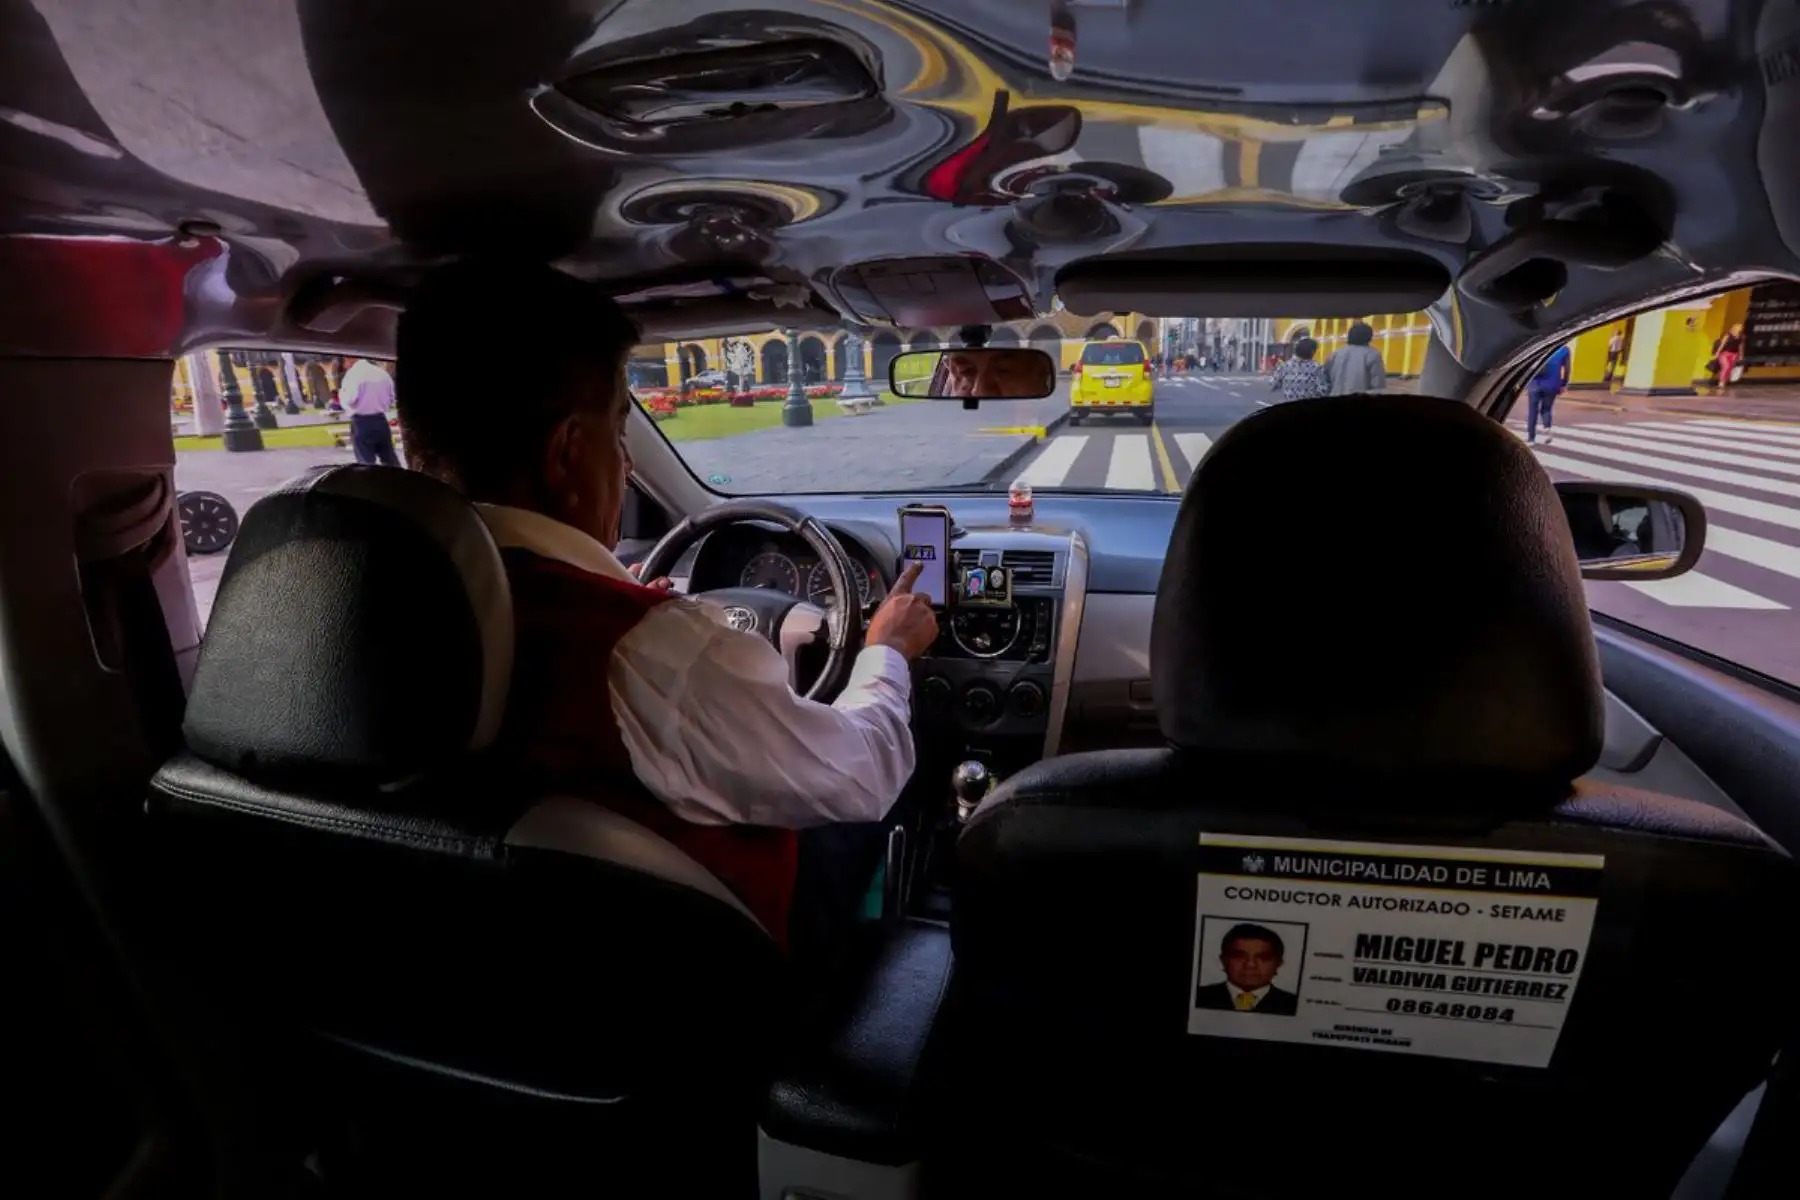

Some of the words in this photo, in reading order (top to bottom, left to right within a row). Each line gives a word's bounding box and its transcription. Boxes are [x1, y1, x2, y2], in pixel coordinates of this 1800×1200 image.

[1273, 855, 1449, 885] MUNICIPALIDAD
[1456, 867, 1487, 887] DE
[1494, 870, 1551, 890] LIMA
[1224, 886, 1340, 907] CONDUCTOR
[1348, 895, 1470, 915] AUTORIZADO
[1490, 904, 1565, 922] SETAME
[1354, 933, 1465, 966] MIGUEL
[1475, 942, 1579, 974] PEDRO
[1353, 967, 1446, 990] VALDIVIA
[1451, 975, 1569, 1000] GUTIERREZ
[1386, 998, 1514, 1022] 08648084
